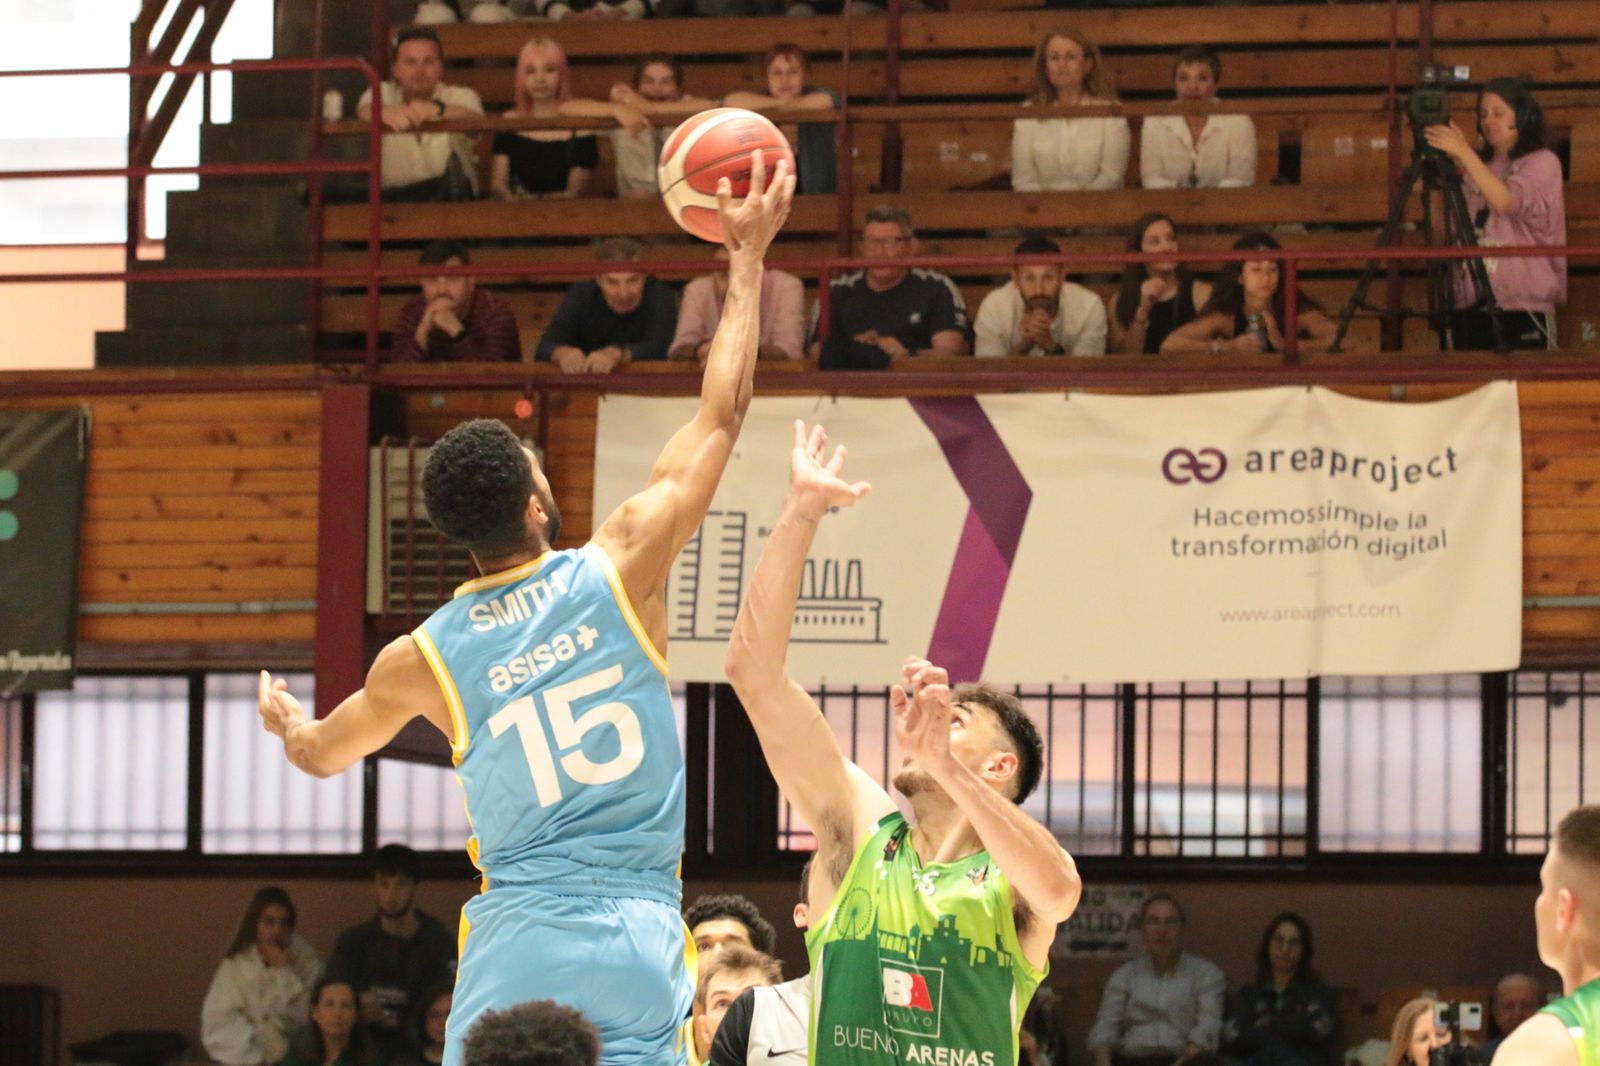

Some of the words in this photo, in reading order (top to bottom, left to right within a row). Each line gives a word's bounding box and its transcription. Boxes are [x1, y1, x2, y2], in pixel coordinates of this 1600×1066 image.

[1244, 445, 1458, 492] areaproject
[1408, 511, 1427, 530] la
[1367, 529, 1447, 560] digital
[468, 571, 569, 633] SMITH
[487, 663, 645, 809] 15
[833, 1024, 900, 1057] BUENO
[905, 1042, 995, 1066] ARENAS
